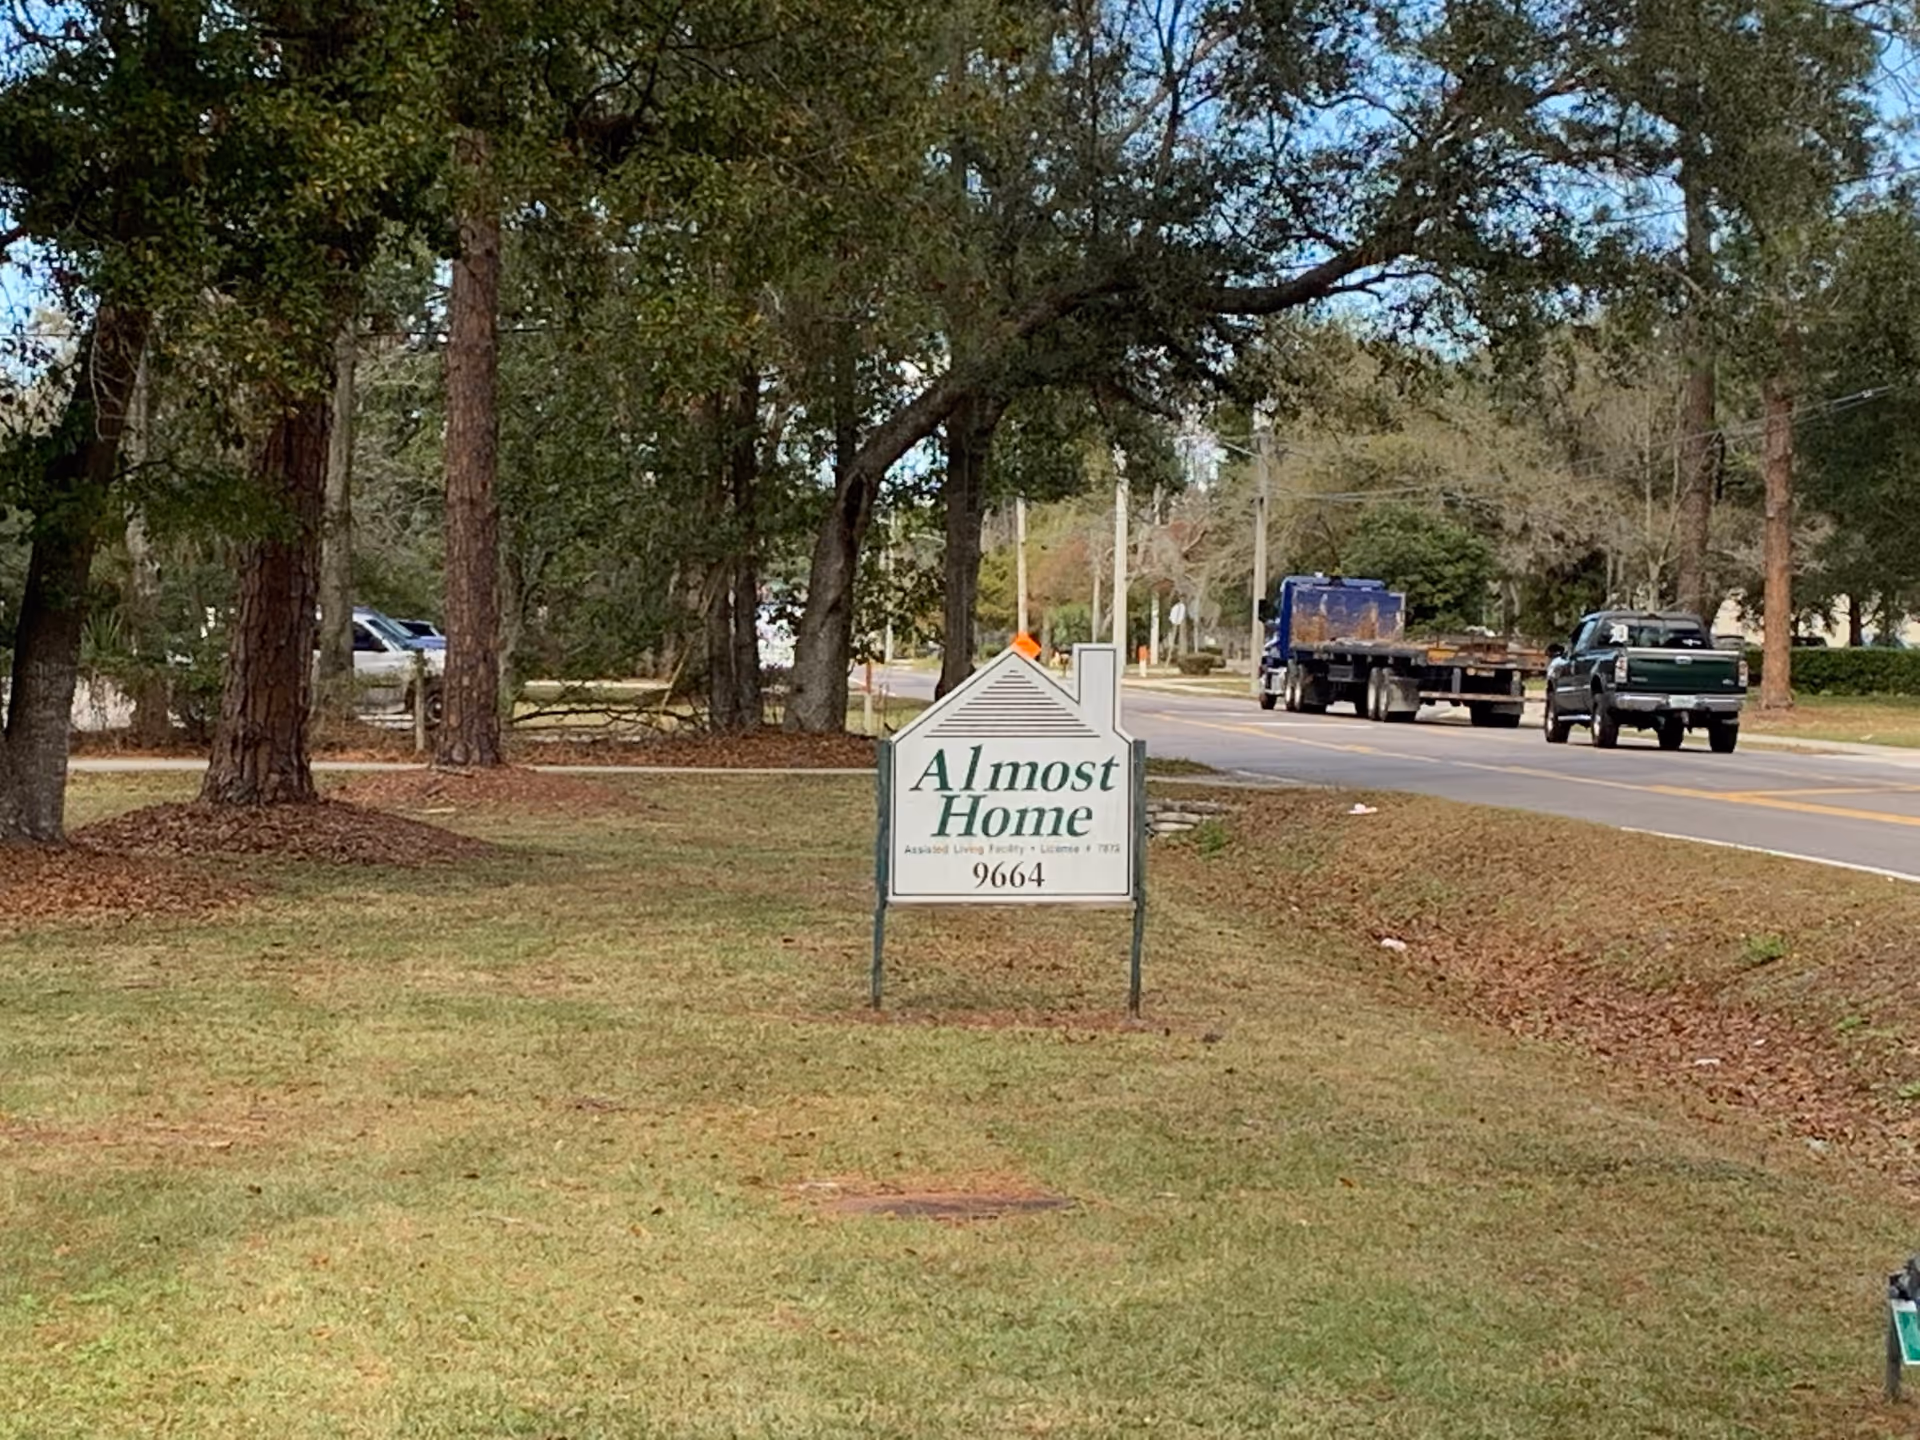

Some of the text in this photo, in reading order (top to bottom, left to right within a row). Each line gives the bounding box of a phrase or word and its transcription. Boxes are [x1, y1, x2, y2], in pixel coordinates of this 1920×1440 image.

[909, 744, 1120, 792] Almost
[930, 794, 1094, 838] Home
[904, 844, 949, 855] Assisted
[953, 844, 985, 856] Living
[988, 844, 1024, 856] Facility
[1040, 844, 1080, 855] License
[973, 862, 1045, 888] 9664
